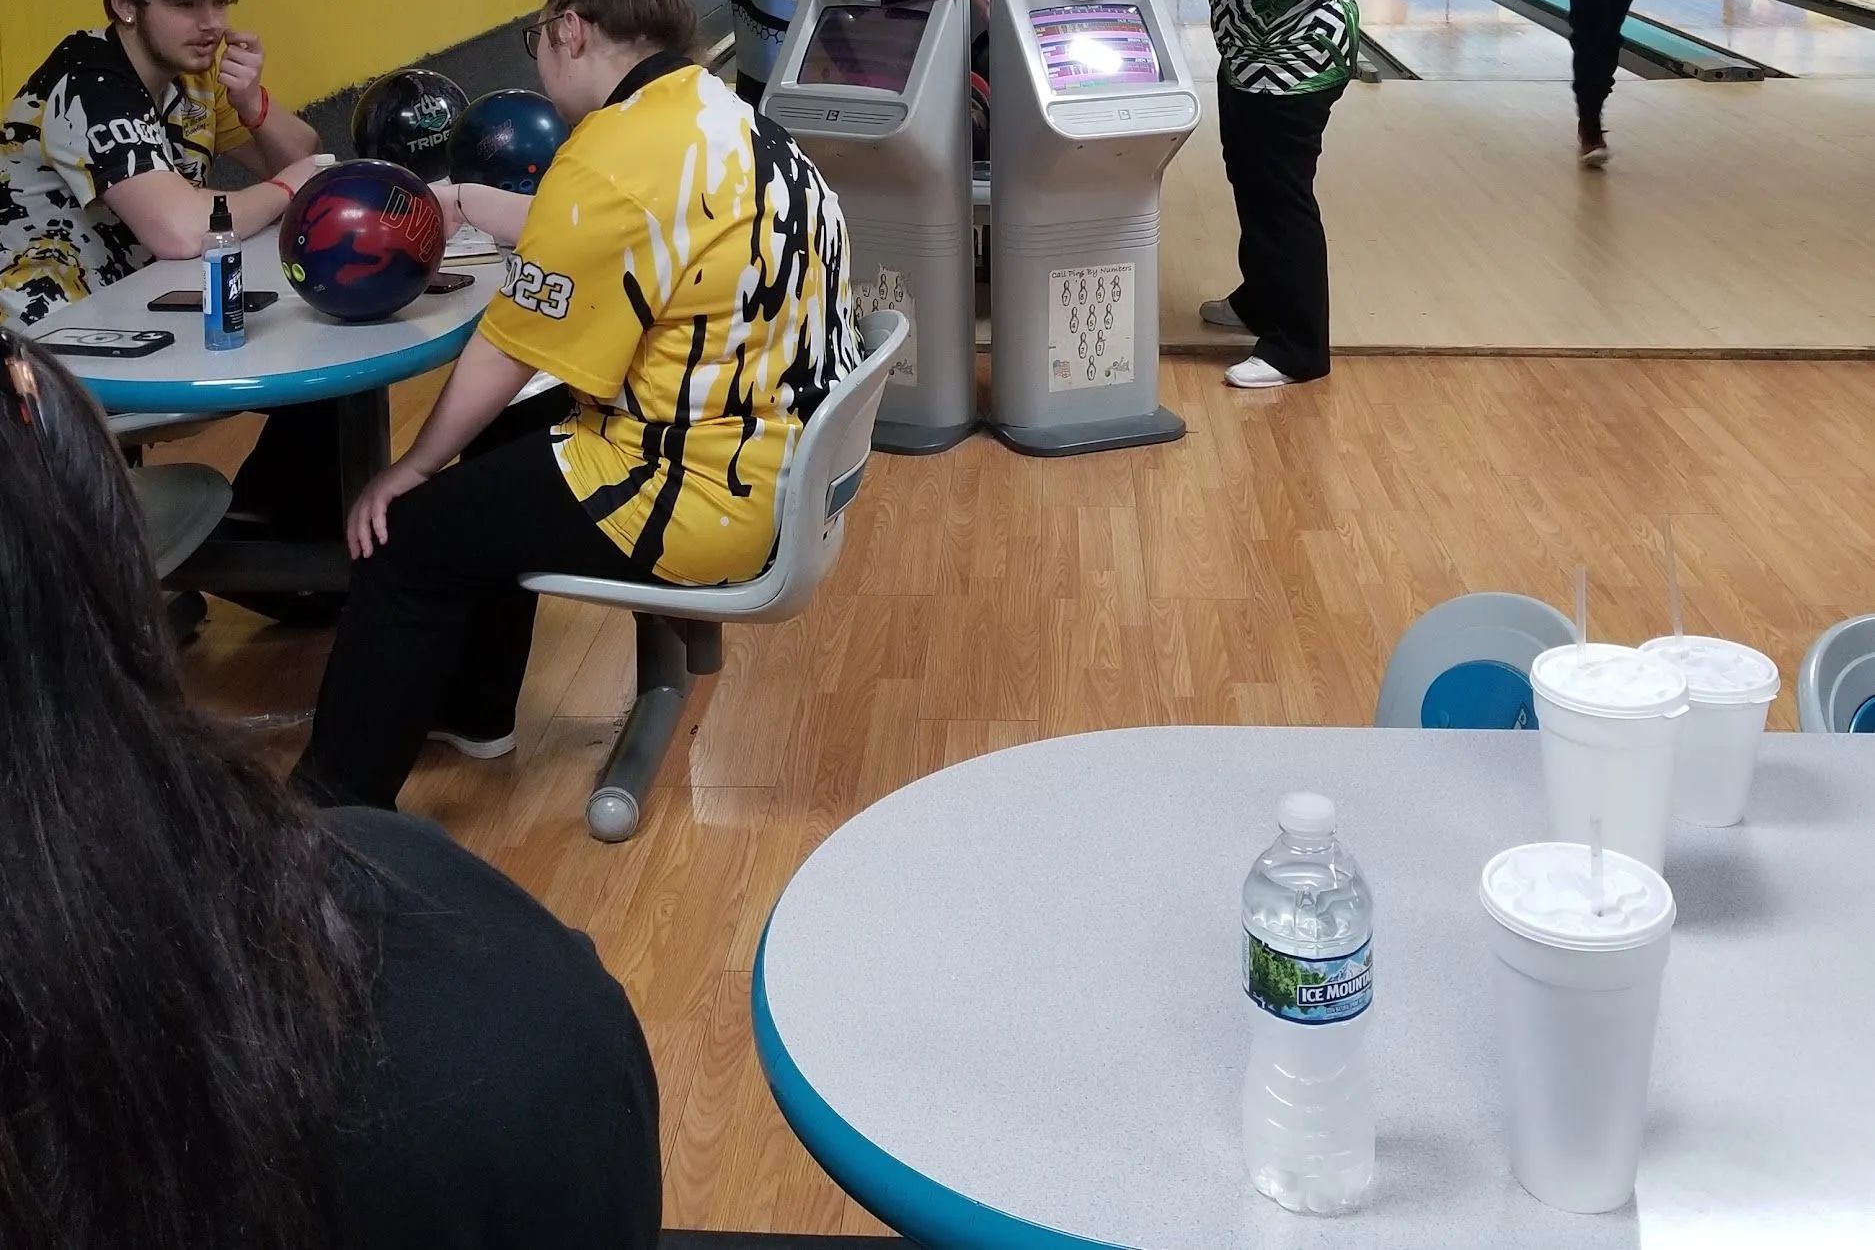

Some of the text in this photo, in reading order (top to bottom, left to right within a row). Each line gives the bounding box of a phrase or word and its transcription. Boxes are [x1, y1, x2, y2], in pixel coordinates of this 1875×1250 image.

[1052, 270, 1066, 279] Call
[1086, 269, 1098, 278] By
[1100, 265, 1132, 274] Numbers
[1302, 988, 1325, 1003] ICE
